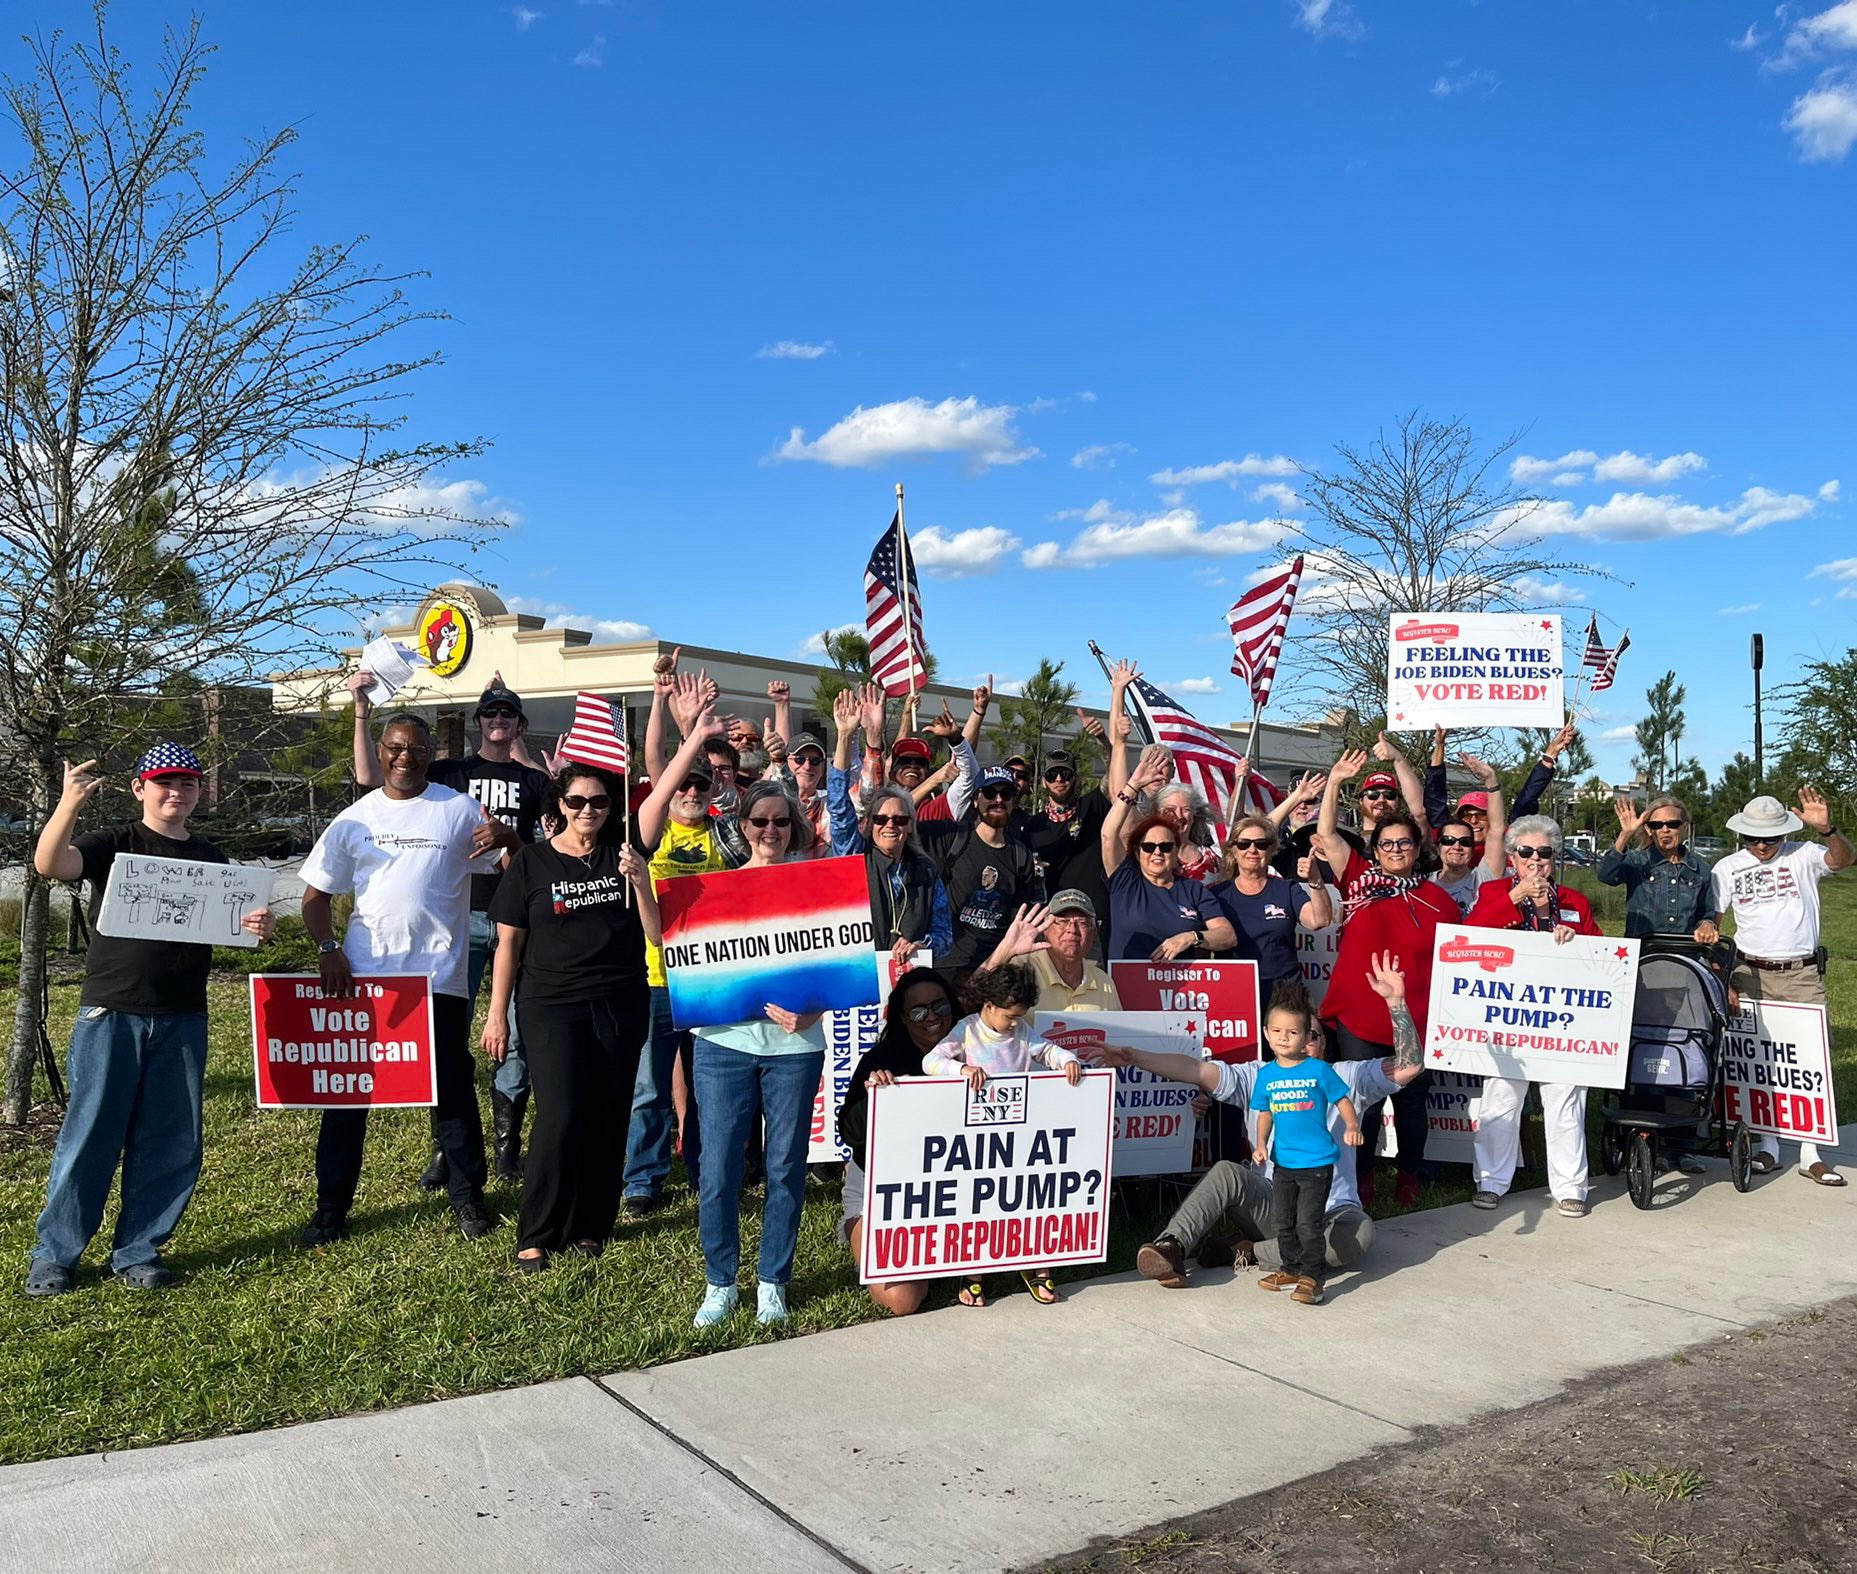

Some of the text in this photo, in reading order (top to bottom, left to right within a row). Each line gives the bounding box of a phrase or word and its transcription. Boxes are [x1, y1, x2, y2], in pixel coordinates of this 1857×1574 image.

[1406, 647, 1551, 663] FEELING THE
[1395, 666, 1563, 680] JOE BIDEN BLUES?
[1414, 684, 1548, 701] VOTE RED!
[468, 778, 520, 810] FIRE
[364, 834, 394, 842] PROUDLY
[125, 860, 204, 878] LOWER
[552, 876, 618, 895] Hispanic
[1735, 866, 1800, 904] USA
[664, 922, 874, 968] ONE NATION UNDER GOD
[1148, 968, 1220, 982] Register To
[365, 983, 384, 998] To
[1160, 988, 1210, 1011] Vote
[1452, 976, 1612, 1009] PAIN AT THE
[310, 1008, 370, 1032] Vote
[1484, 1005, 1574, 1030] PUMP?
[268, 1038, 418, 1065] Republican
[1437, 1025, 1619, 1056] VOTE REPUBLICAN!
[1760, 1040, 1798, 1064] THE
[312, 1069, 374, 1094] Here
[1266, 1079, 1317, 1091] CURRENT
[1754, 1063, 1823, 1092] BLUES?
[1130, 1089, 1200, 1108] BLUES?
[1272, 1090, 1308, 1100] MOOD:
[982, 1105, 1010, 1121] NY
[1749, 1088, 1826, 1135] RED!
[1125, 1114, 1182, 1138] RED!
[922, 1132, 1014, 1173] PAIN
[1026, 1128, 1076, 1166] AT
[876, 1169, 1102, 1221] THE PUMP?
[875, 1212, 1099, 1270] VOTE REPUBLICAN!
